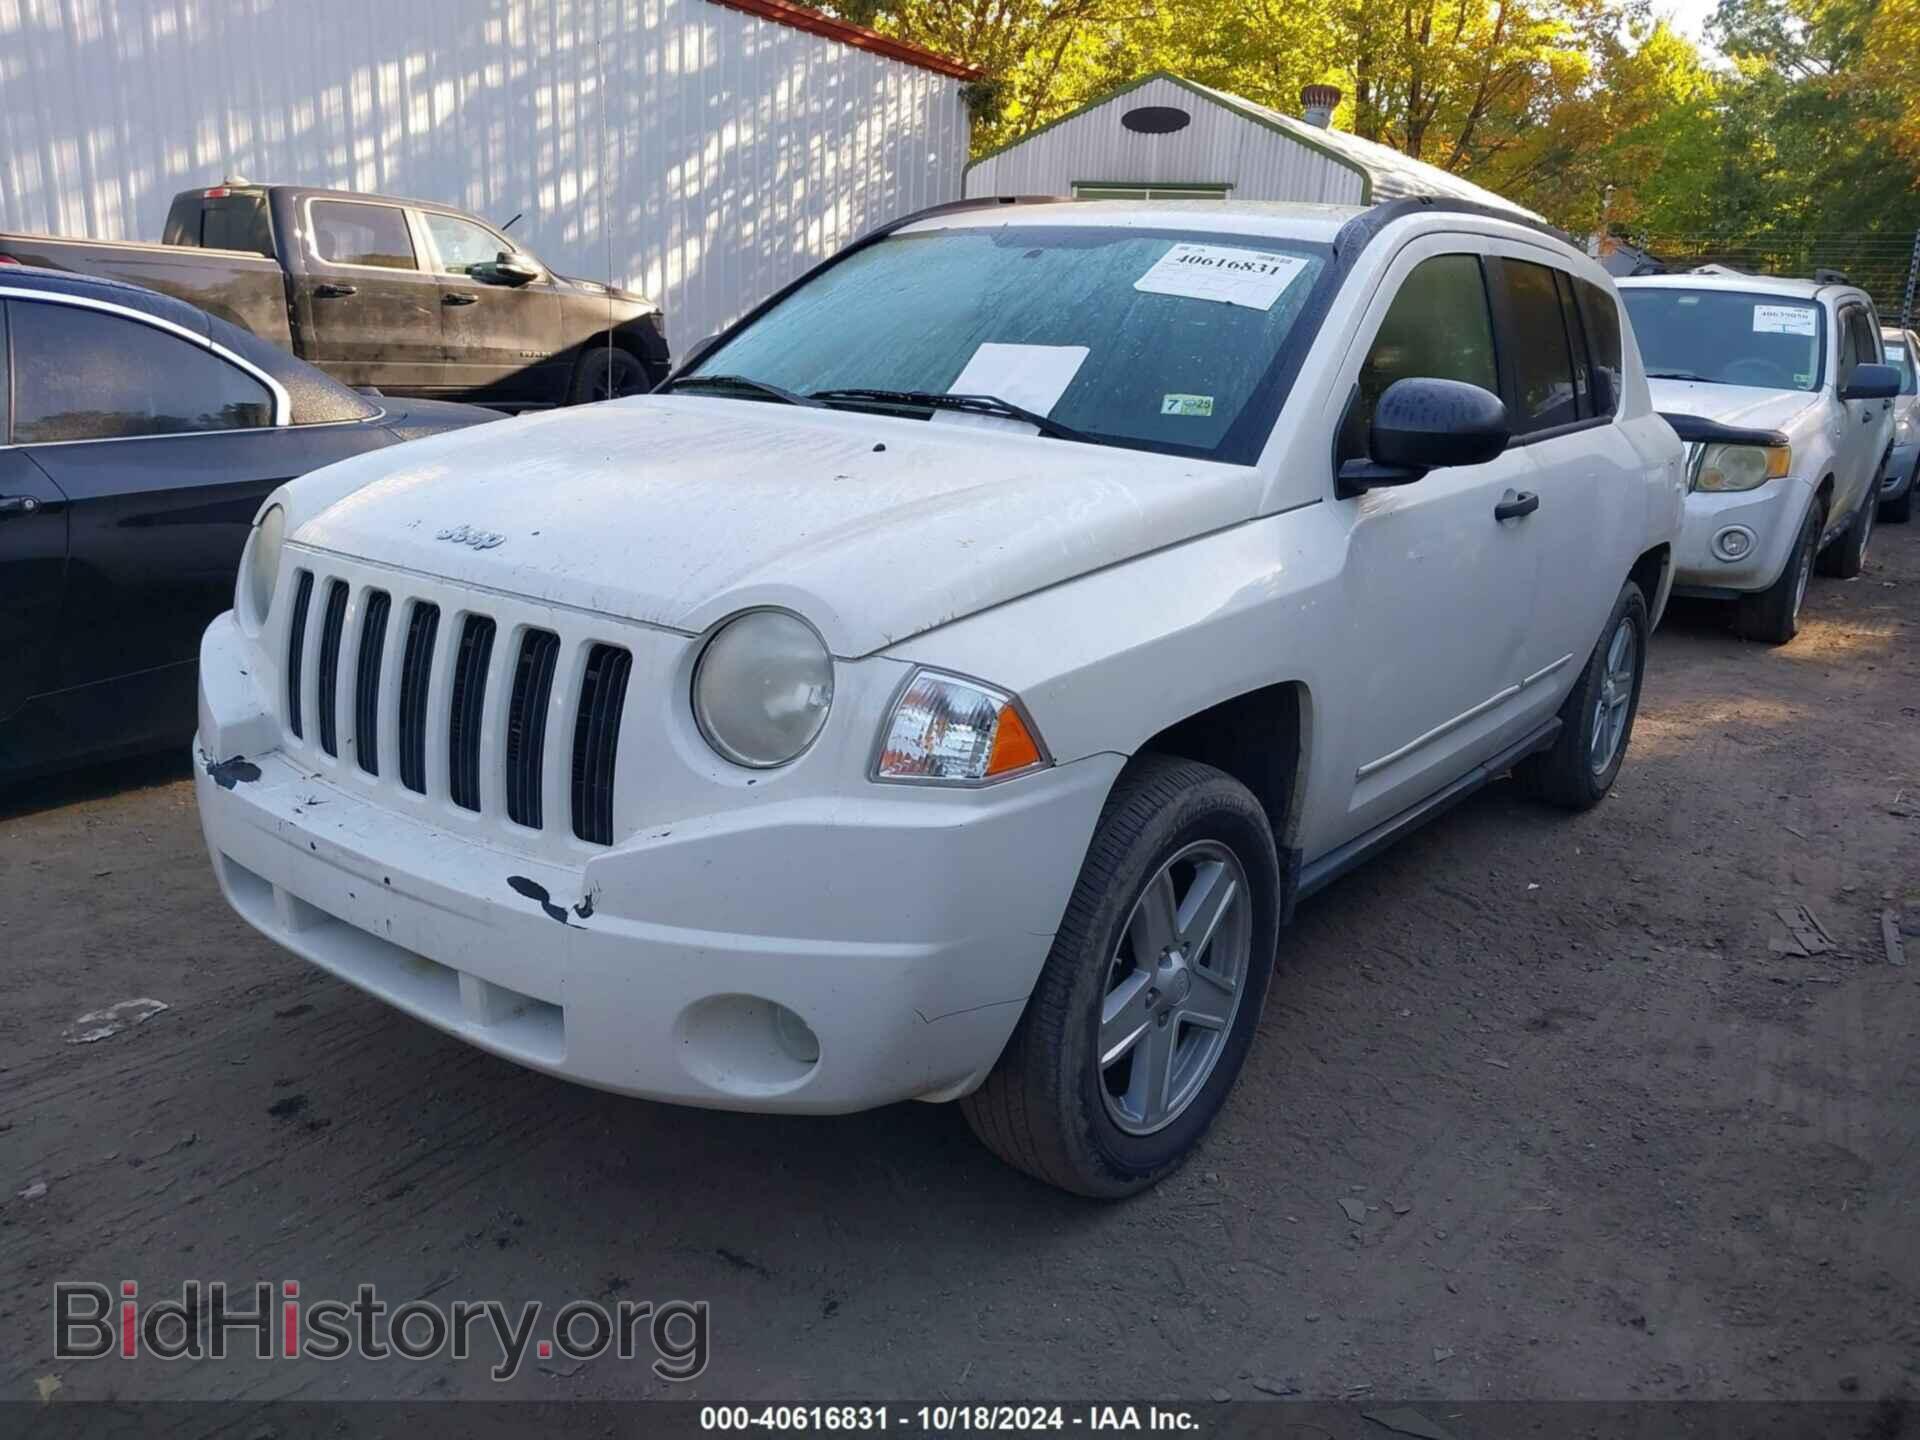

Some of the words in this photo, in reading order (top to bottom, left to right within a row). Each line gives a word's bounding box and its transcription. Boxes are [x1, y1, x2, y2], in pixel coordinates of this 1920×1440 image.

[1176, 254, 1280, 276] 40616831
[1167, 399, 1179, 411] 7
[434, 525, 506, 552] Jeep
